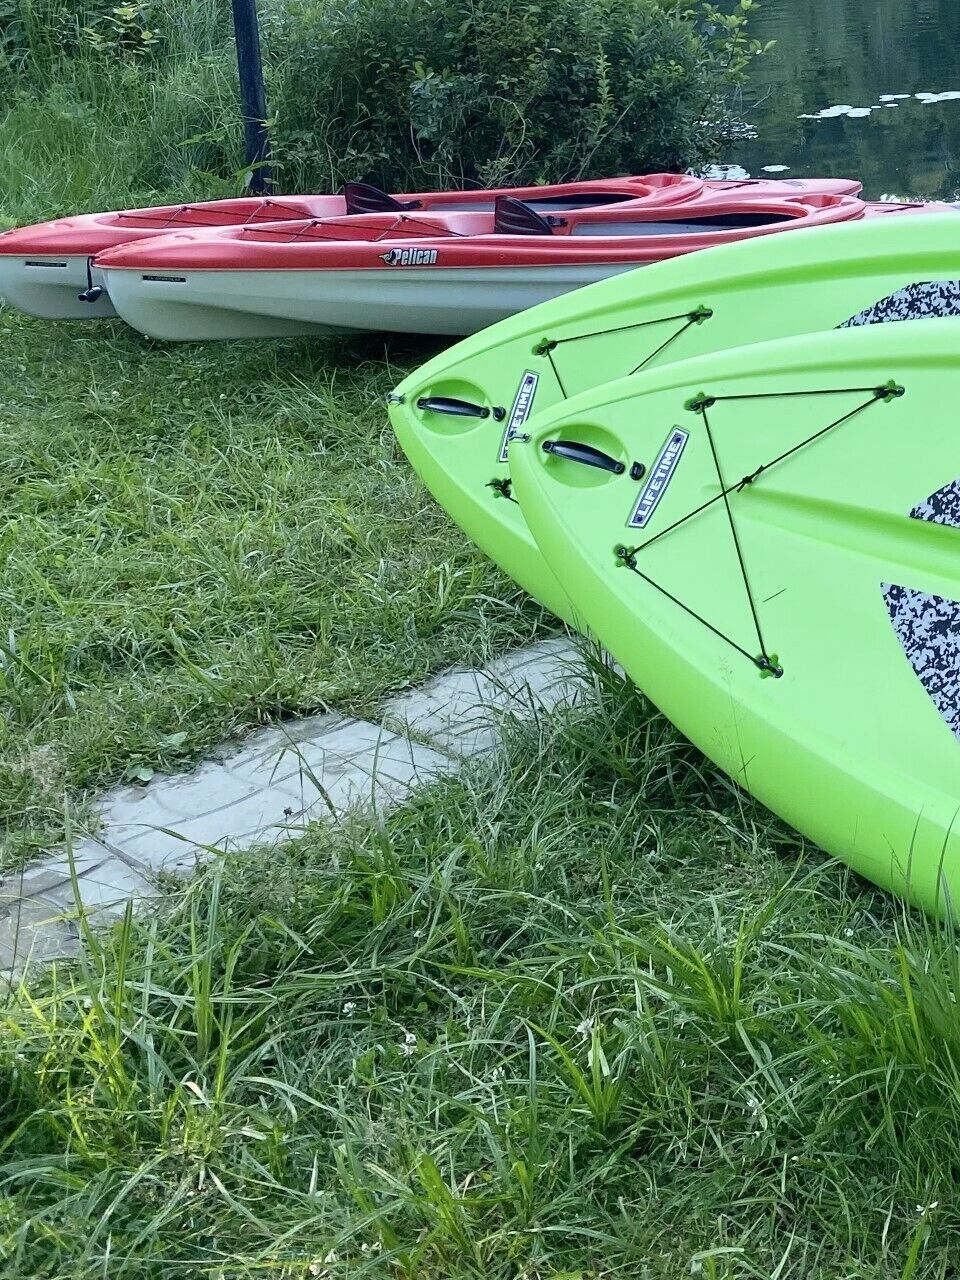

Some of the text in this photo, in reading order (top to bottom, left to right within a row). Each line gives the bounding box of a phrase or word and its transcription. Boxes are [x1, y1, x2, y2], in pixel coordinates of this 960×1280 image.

[388, 247, 438, 265] Pelican
[509, 383, 531, 434] ETIME
[637, 441, 681, 517] LIFETIME
